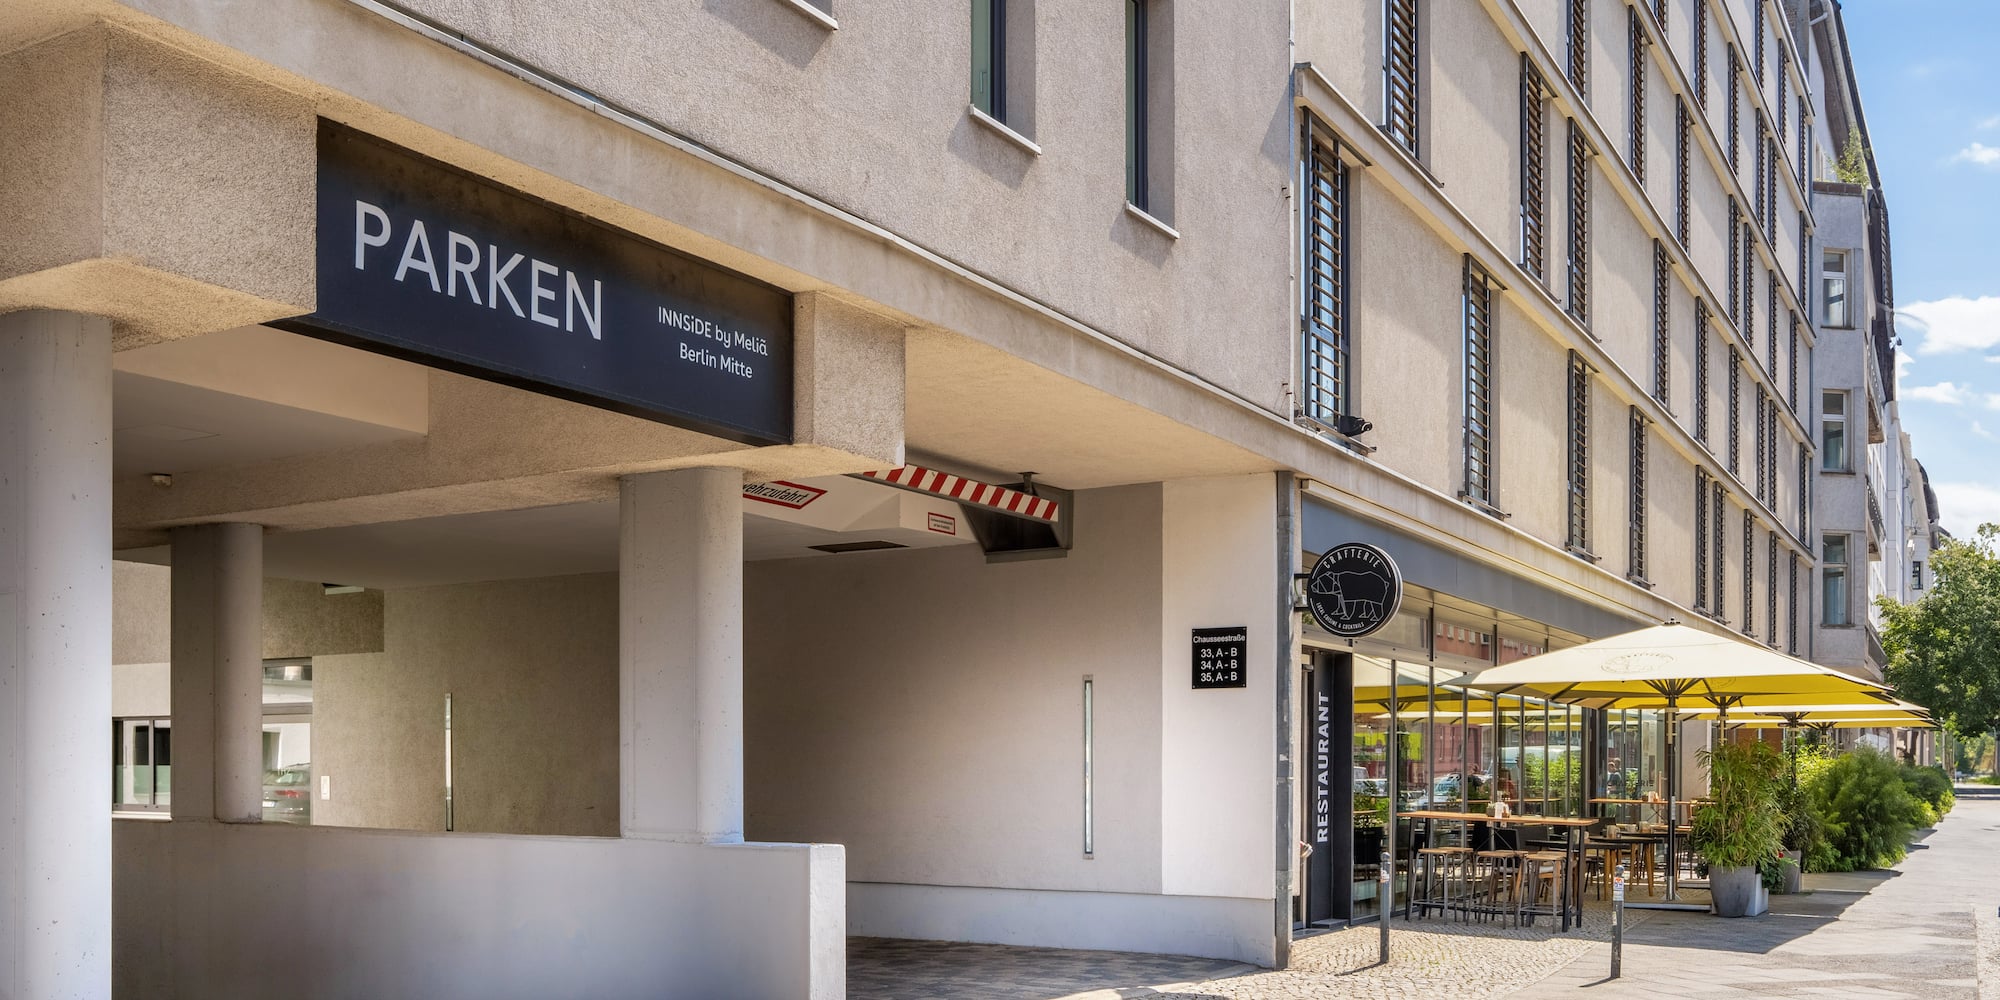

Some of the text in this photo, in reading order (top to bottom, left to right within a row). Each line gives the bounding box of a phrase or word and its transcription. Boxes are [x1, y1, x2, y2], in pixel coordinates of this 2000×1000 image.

[354, 199, 603, 341] PARKEN
[658, 306, 712, 339] INNSiDE
[715, 325, 731, 348] by
[680, 342, 753, 379] Berlin Mitte
[1323, 549, 1381, 569] CRAFTERIE
[1192, 633, 1246, 644] Chausseestraße
[1200, 648, 1215, 659] 33,
[1215, 647, 1224, 658] A
[1230, 647, 1238, 657] B
[1200, 660, 1215, 671] 34,
[1215, 659, 1224, 670] A
[1230, 659, 1238, 669] B
[1200, 672, 1215, 683] 35,
[1215, 671, 1224, 682] A
[1230, 671, 1238, 681] B
[1317, 691, 1329, 843] RESTAURANT
